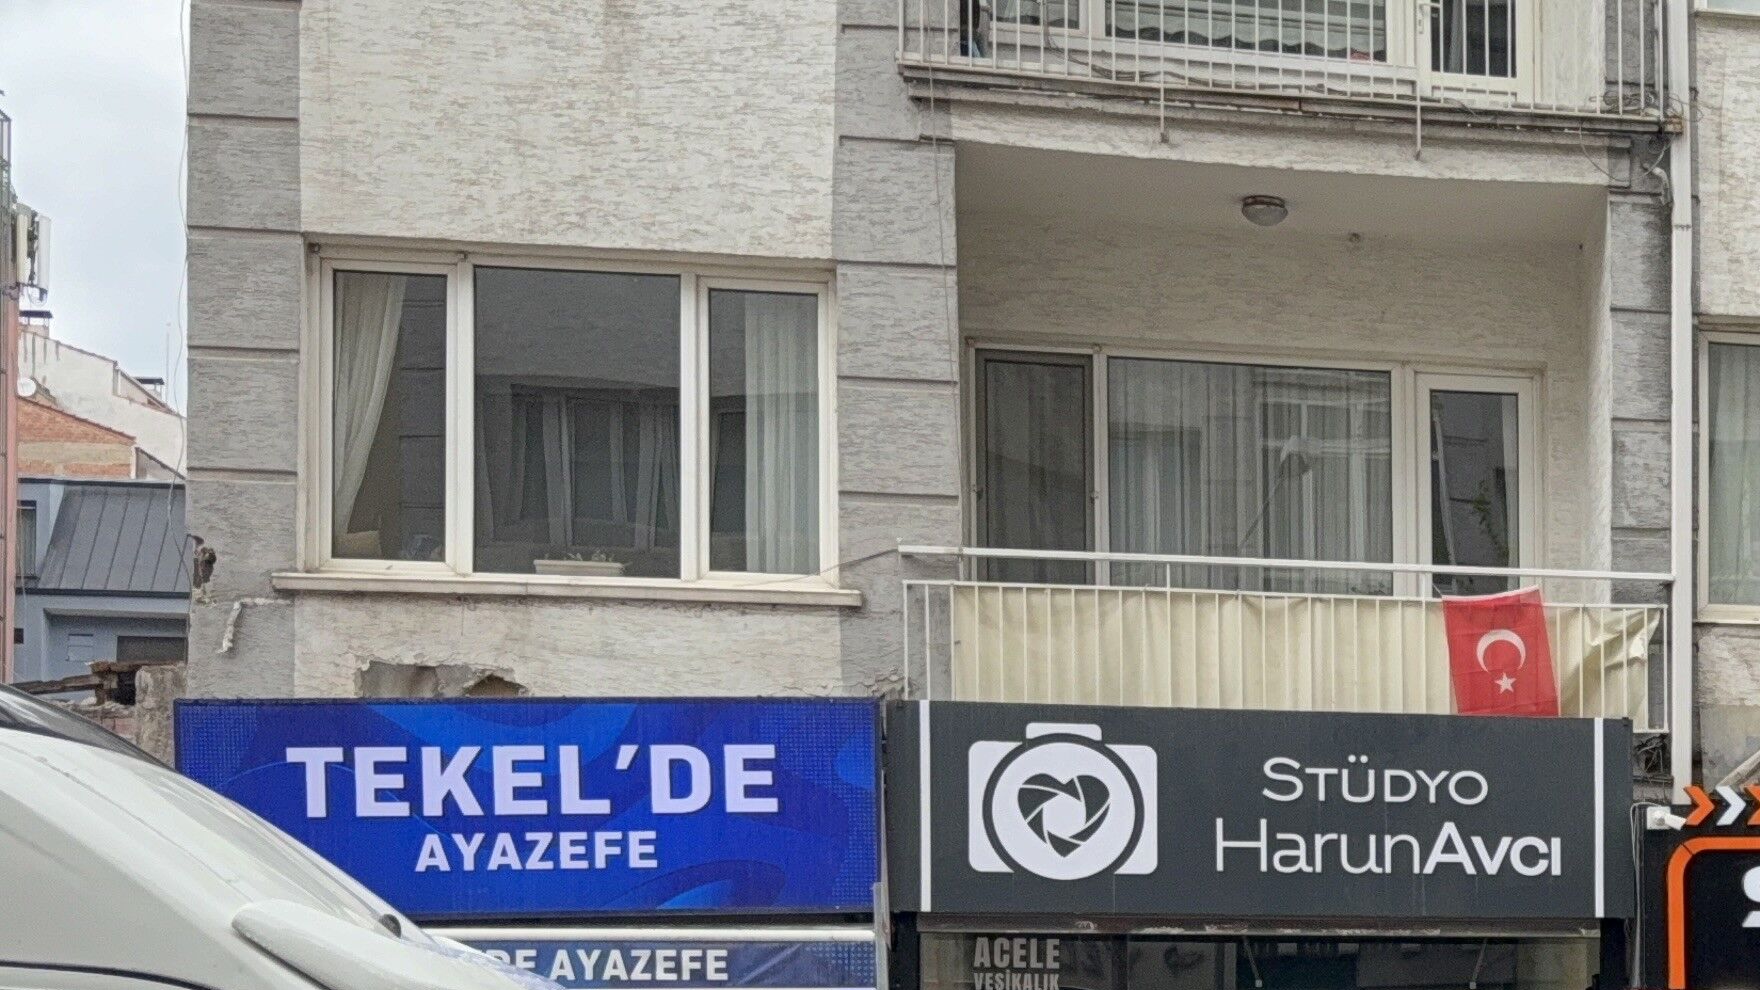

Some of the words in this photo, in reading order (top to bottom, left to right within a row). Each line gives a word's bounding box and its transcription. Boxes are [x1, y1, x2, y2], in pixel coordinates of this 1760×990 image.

[286, 743, 779, 819] TEKEL'DE
[415, 830, 658, 872] AYAZEFE
[550, 949, 729, 981] AYAZEFE
[973, 937, 1060, 969] ACELE
